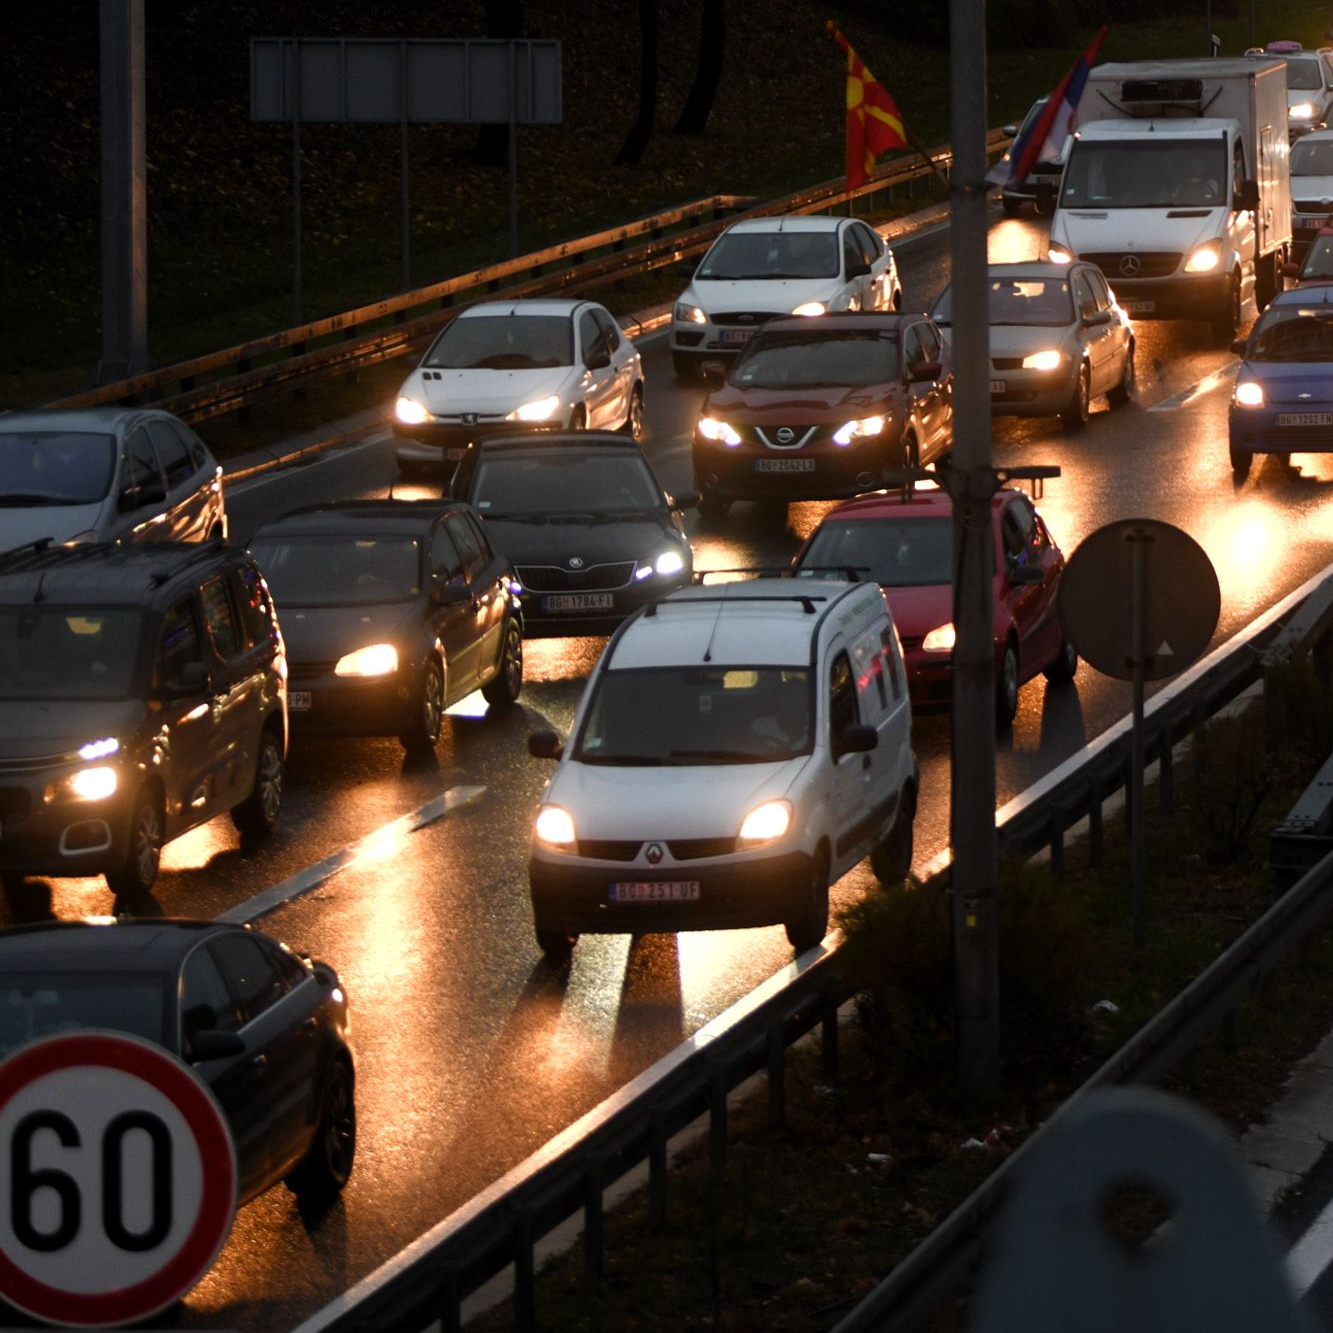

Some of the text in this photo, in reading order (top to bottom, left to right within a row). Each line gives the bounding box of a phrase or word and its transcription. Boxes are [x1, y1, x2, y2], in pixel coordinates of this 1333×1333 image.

[618, 881, 698, 900] BG 251-UF
[10, 1109, 173, 1252] 60
